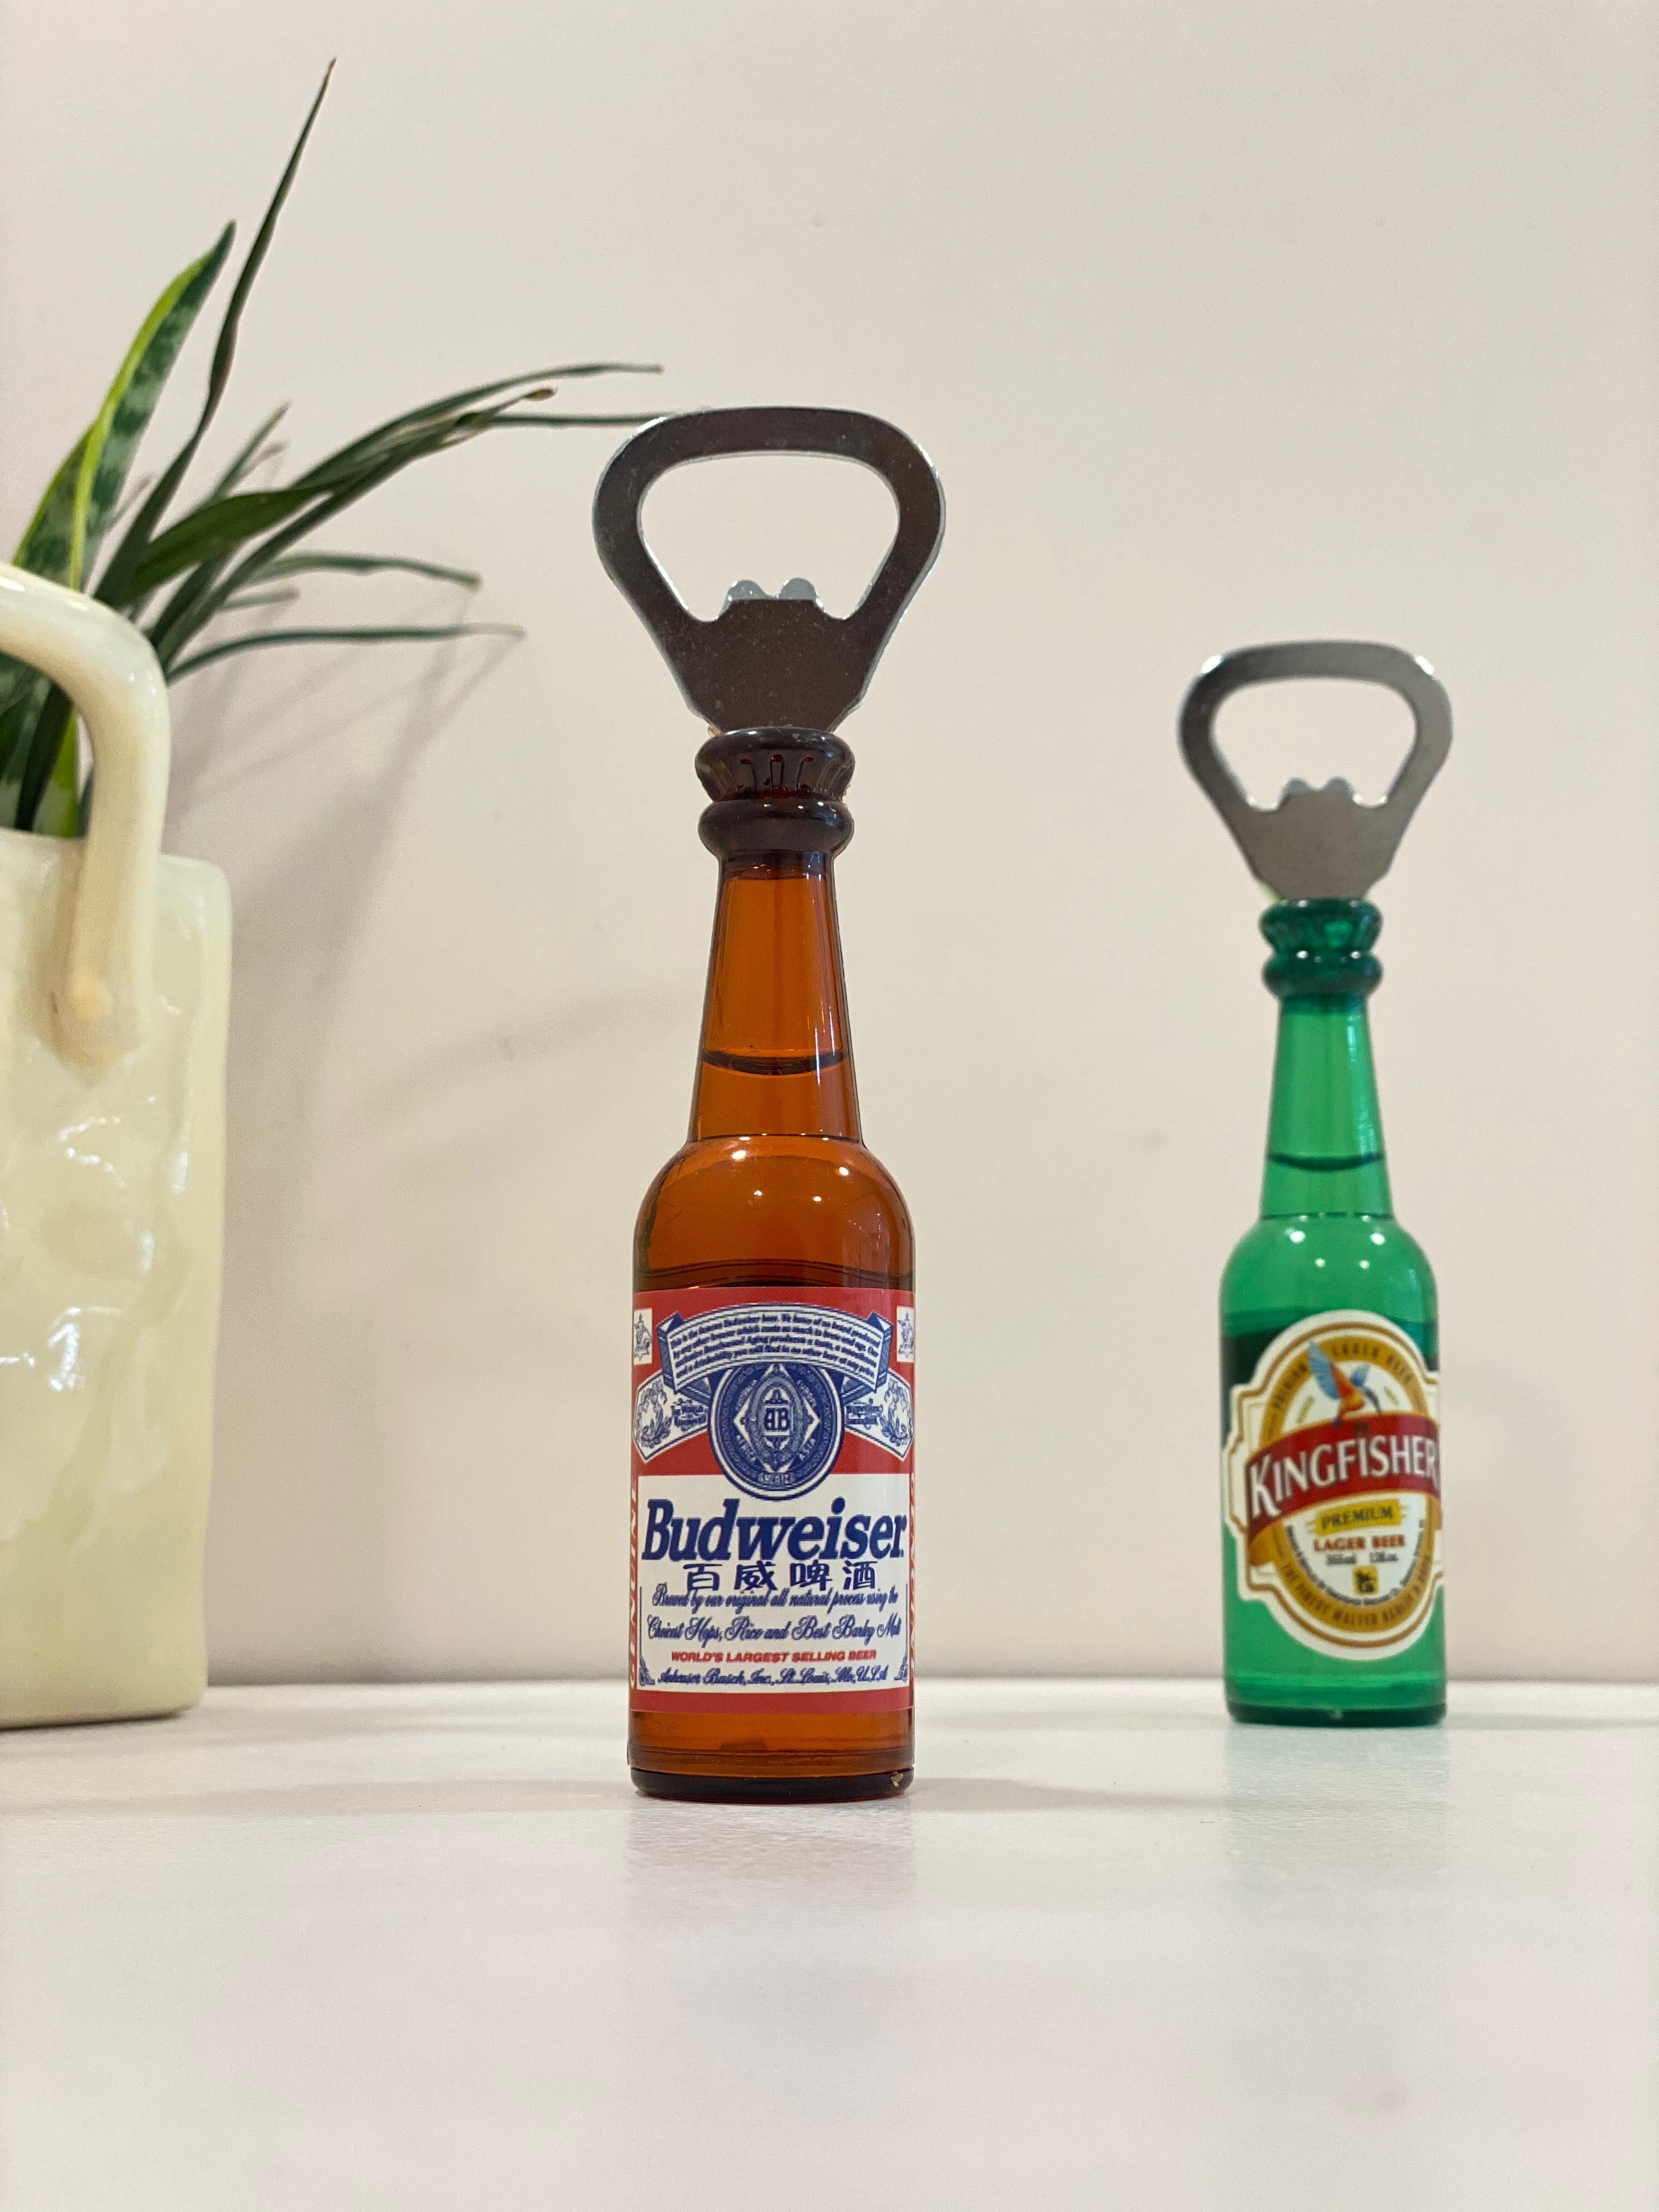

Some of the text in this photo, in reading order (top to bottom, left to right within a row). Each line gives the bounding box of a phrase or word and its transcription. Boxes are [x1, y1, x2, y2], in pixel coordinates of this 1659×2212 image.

[1249, 1434, 1441, 1519] KINGFISHER
[641, 1497, 907, 1560] Budweiser
[1321, 1505, 1394, 1530] PREMIUM
[1313, 1534, 1405, 1552] LAGER BEER
[682, 1560, 878, 1591] 百威啤酒
[764, 1621, 792, 1640] and
[792, 1615, 831, 1640] Best
[672, 1649, 877, 1663] WORLD'S LARGEST SELLING BEER
